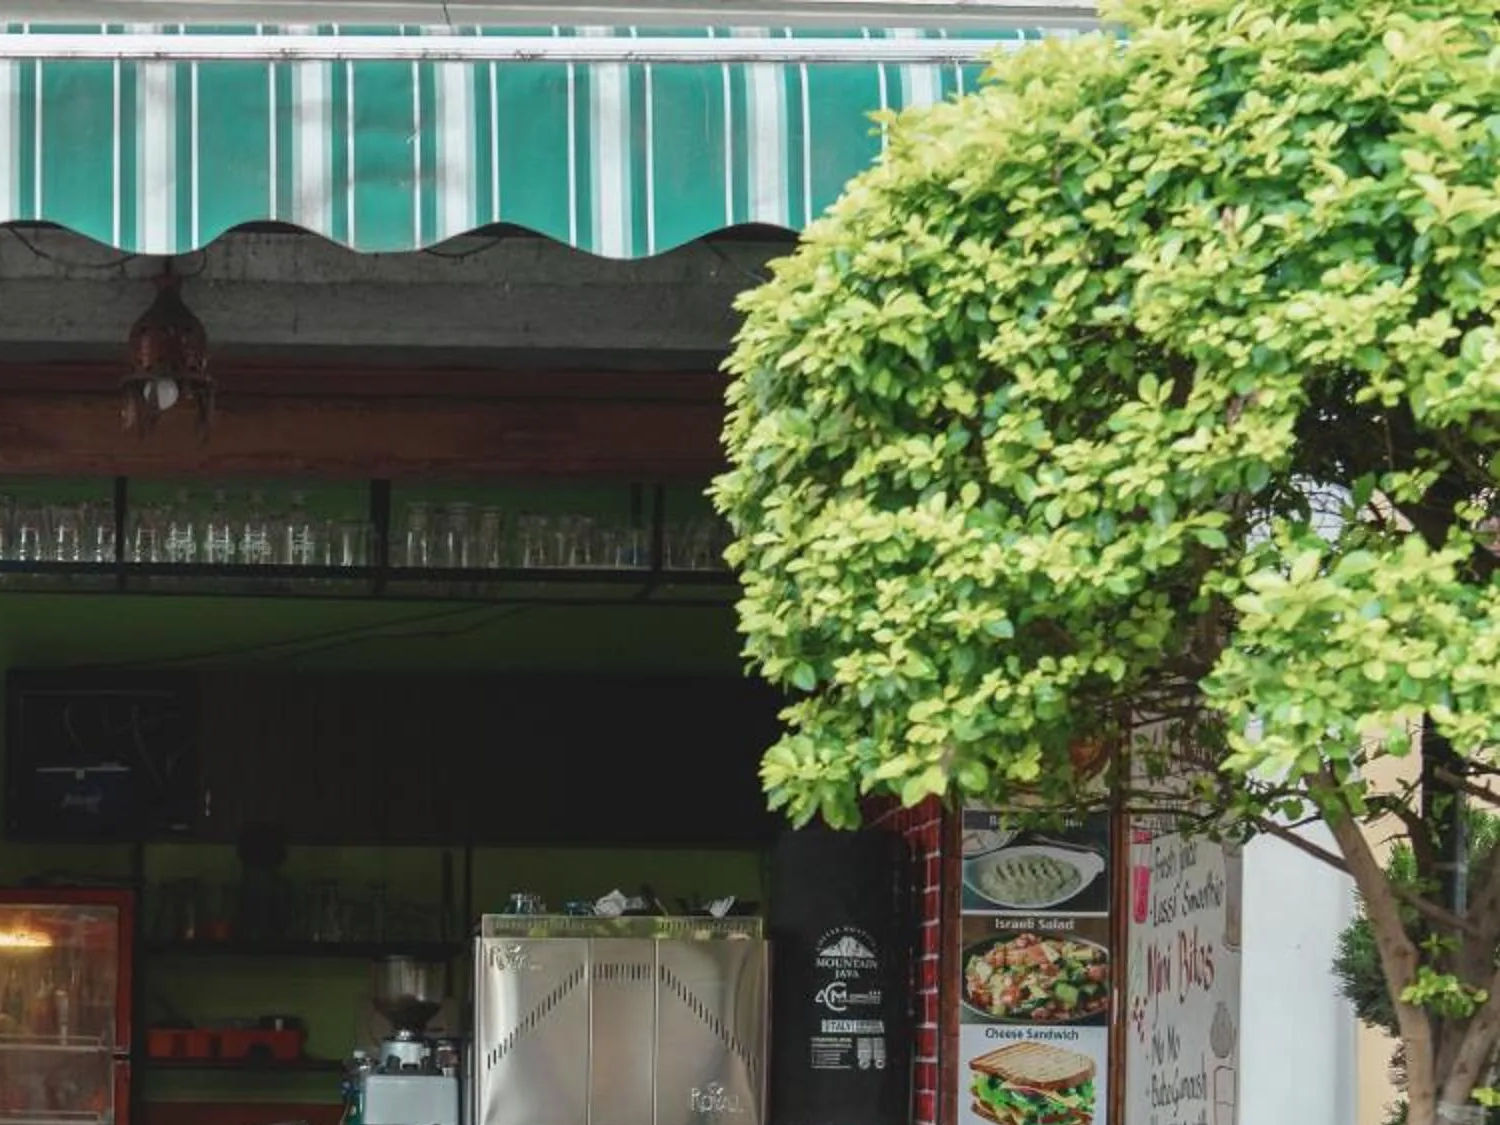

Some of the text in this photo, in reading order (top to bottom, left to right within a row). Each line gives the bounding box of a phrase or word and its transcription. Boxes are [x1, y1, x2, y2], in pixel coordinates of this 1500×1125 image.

[994, 917, 1076, 930] Israeli Salad
[815, 957, 877, 969] MOUNTAIN
[1178, 925, 1216, 992] Bites
[984, 1027, 1080, 1040] Cheese Sandwich
